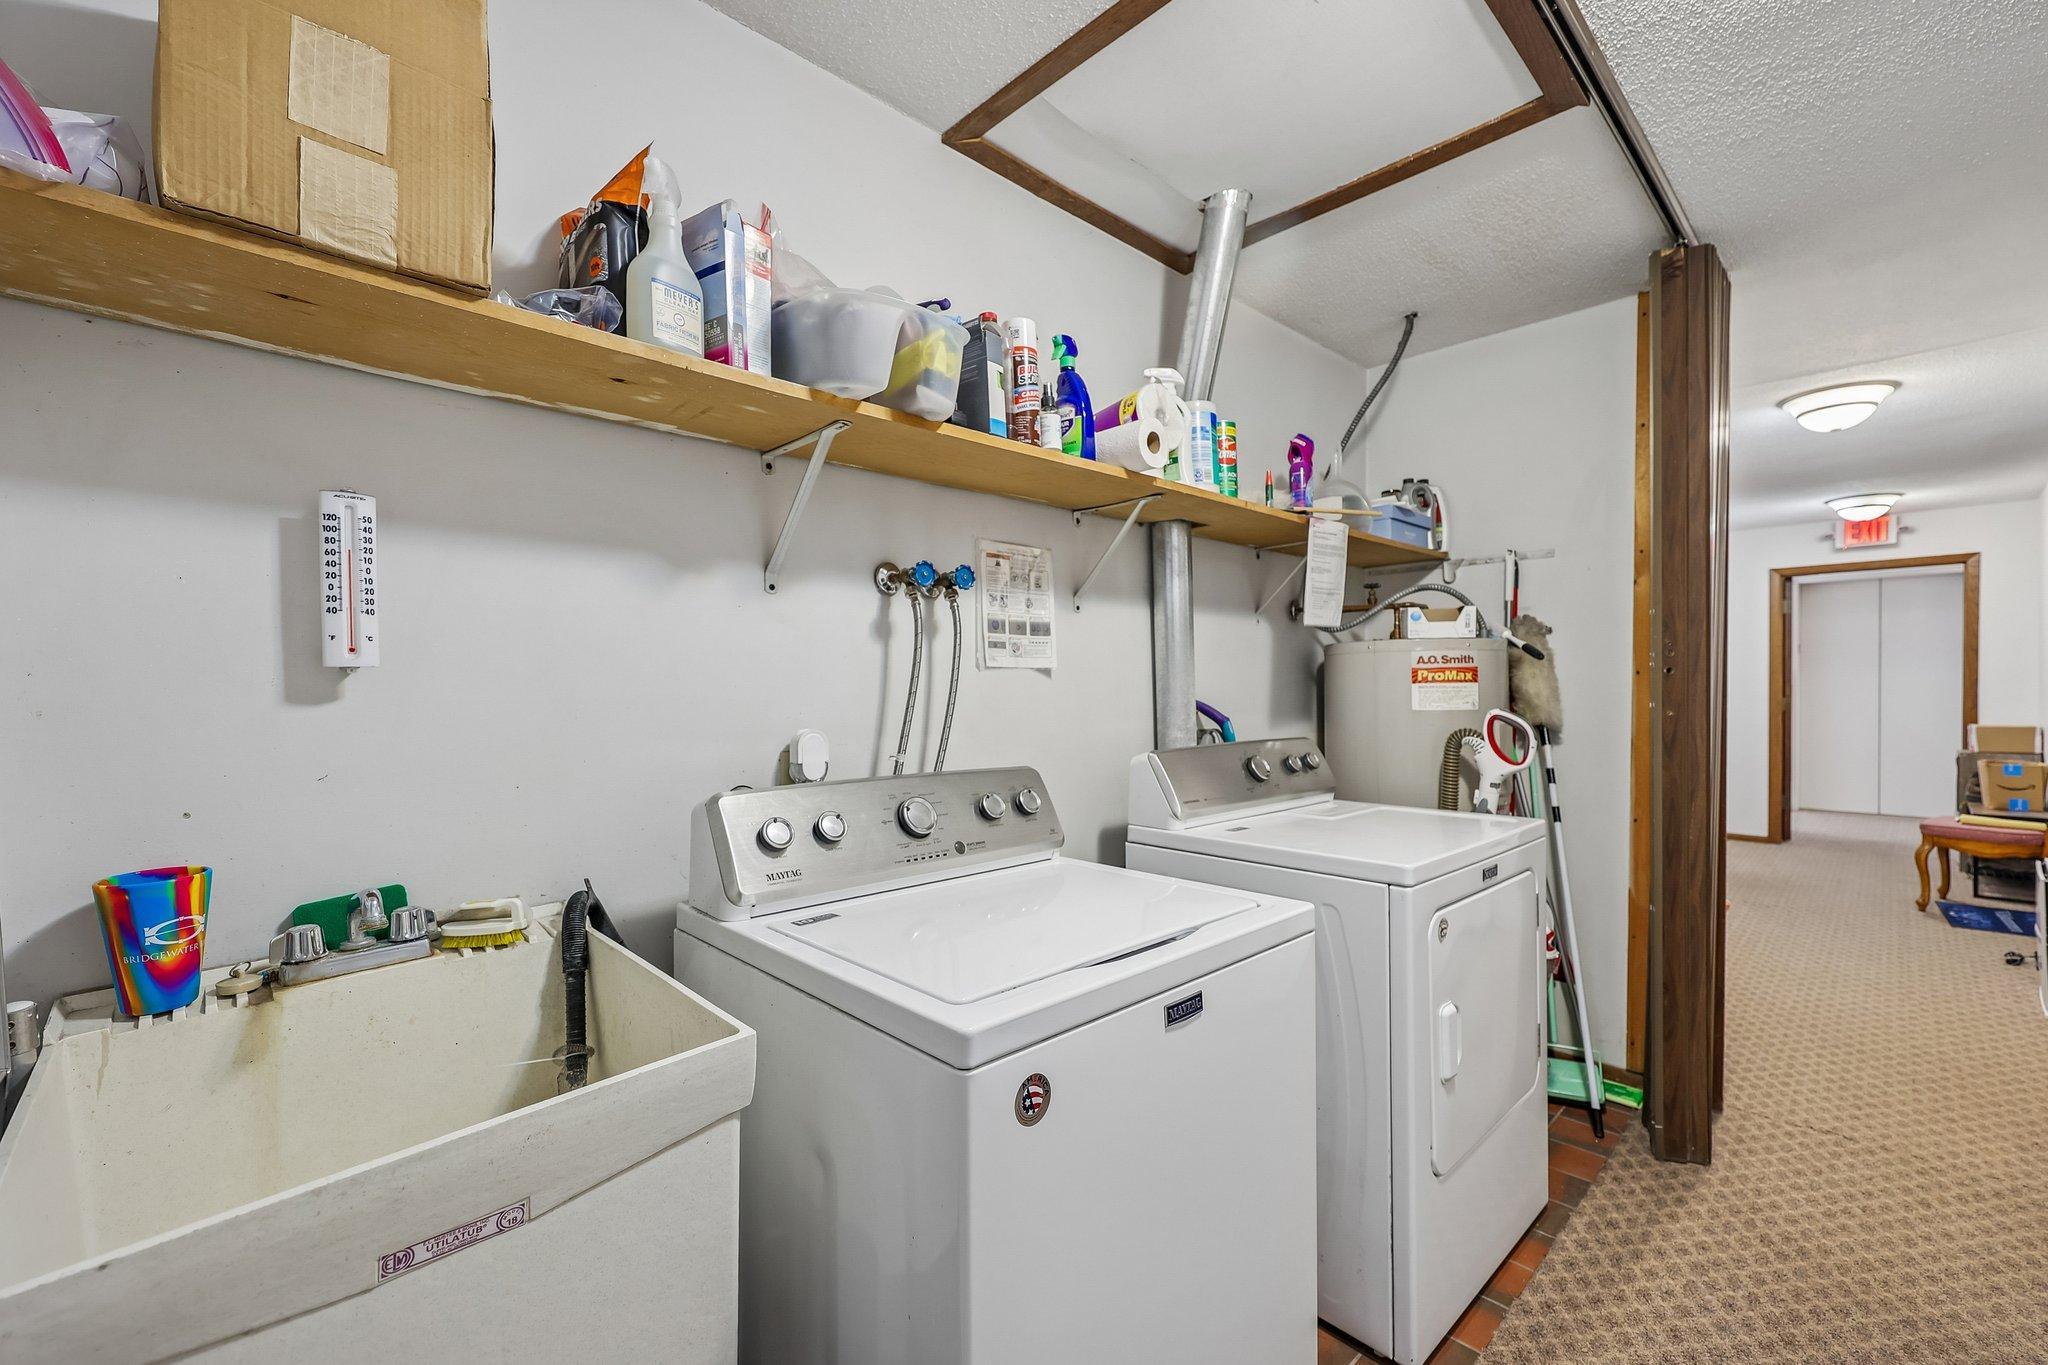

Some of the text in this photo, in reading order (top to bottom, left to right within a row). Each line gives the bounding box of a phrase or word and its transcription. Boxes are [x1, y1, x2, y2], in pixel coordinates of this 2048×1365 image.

[322, 513, 337, 521] 120
[361, 516, 373, 524] 50
[322, 525, 338, 533] 100
[362, 527, 373, 535] 40
[324, 536, 336, 545] 80
[324, 548, 337, 556] 60
[363, 547, 374, 555] 20
[325, 560, 337, 568] 40
[363, 556, 373, 565] 10
[325, 571, 337, 579] 20
[365, 567, 371, 575] 0
[363, 577, 374, 585] 10
[328, 583, 335, 591] 0
[364, 588, 375, 596] 20
[364, 598, 375, 606] 30
[325, 606, 338, 614] 40
[364, 608, 376, 616] 40
[1417, 654, 1474, 665] A.O. Smith
[1417, 669, 1473, 681] ProMax
[766, 868, 802, 882] MAYTAG
[123, 942, 200, 964] BRIDGEWATER
[1168, 997, 1202, 1021] MAYTAG
[506, 1215, 518, 1226] 18
